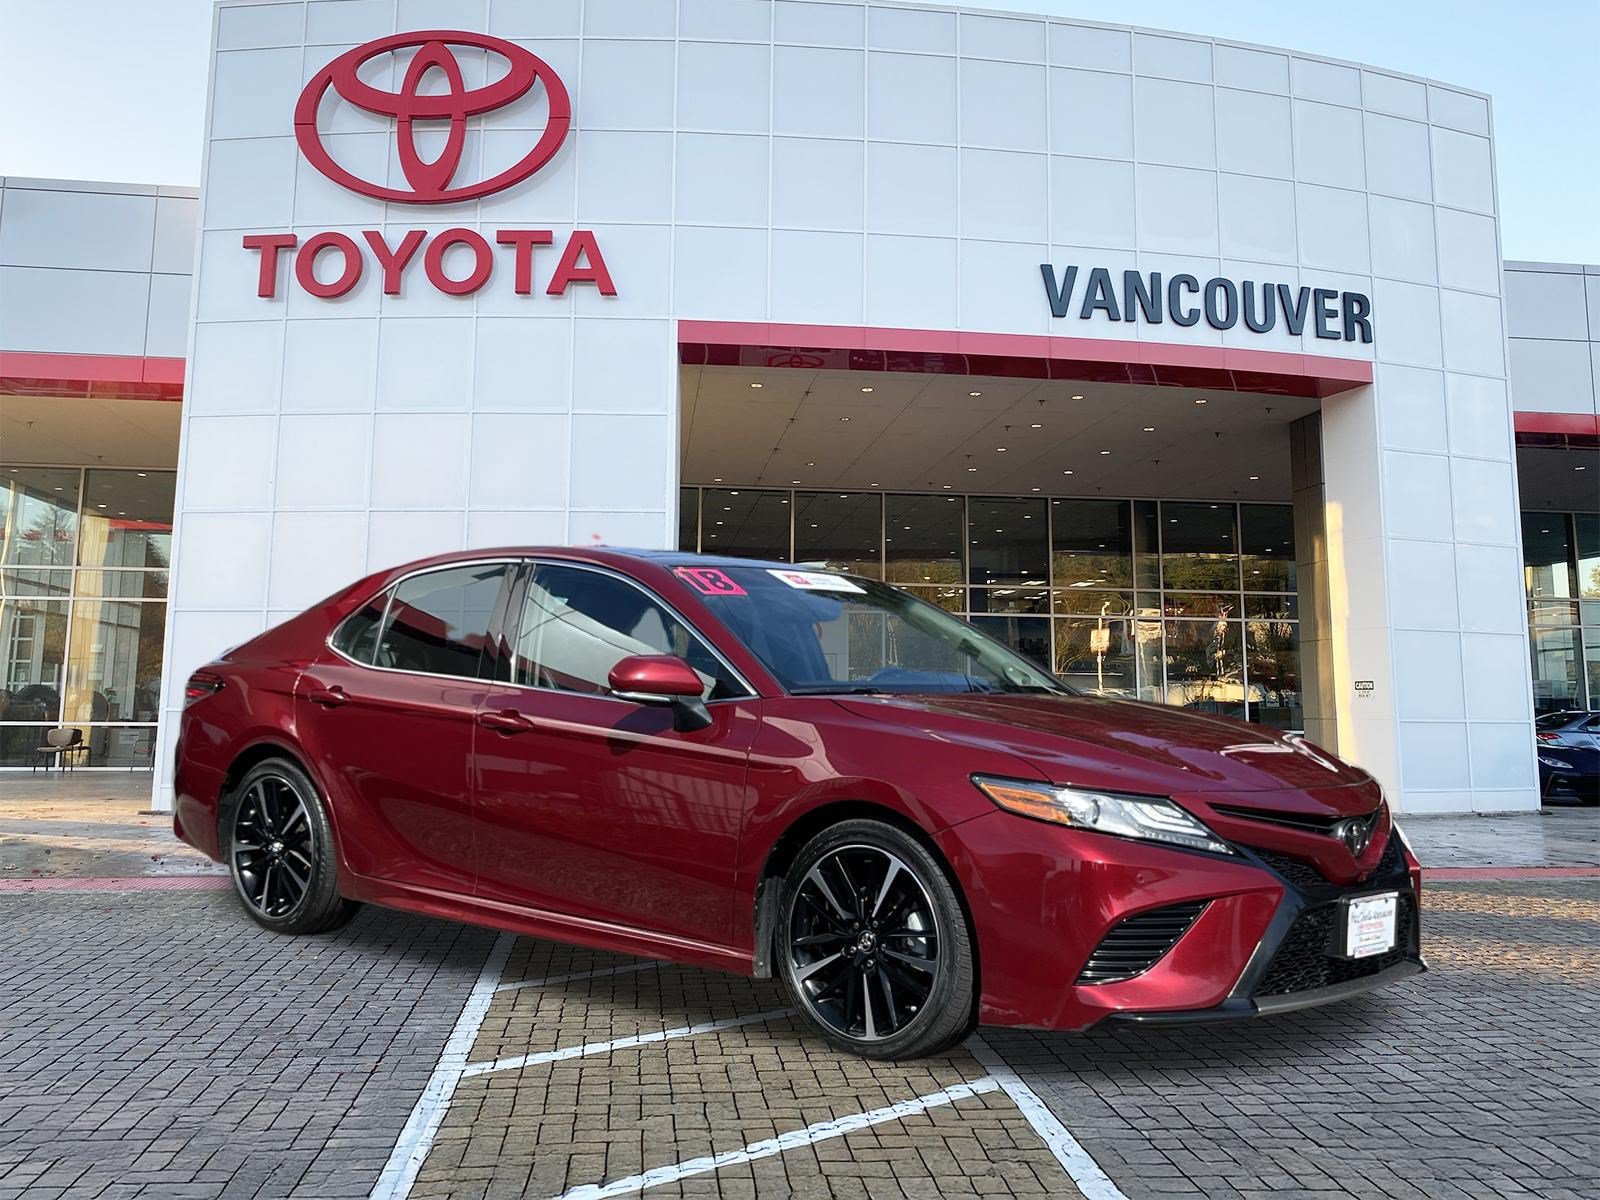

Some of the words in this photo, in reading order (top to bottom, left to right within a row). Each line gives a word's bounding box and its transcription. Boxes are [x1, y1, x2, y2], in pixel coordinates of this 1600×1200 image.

[243, 228, 618, 299] TOYOTA
[1040, 264, 1374, 343] VANCOUVER
[684, 570, 735, 592] 18
